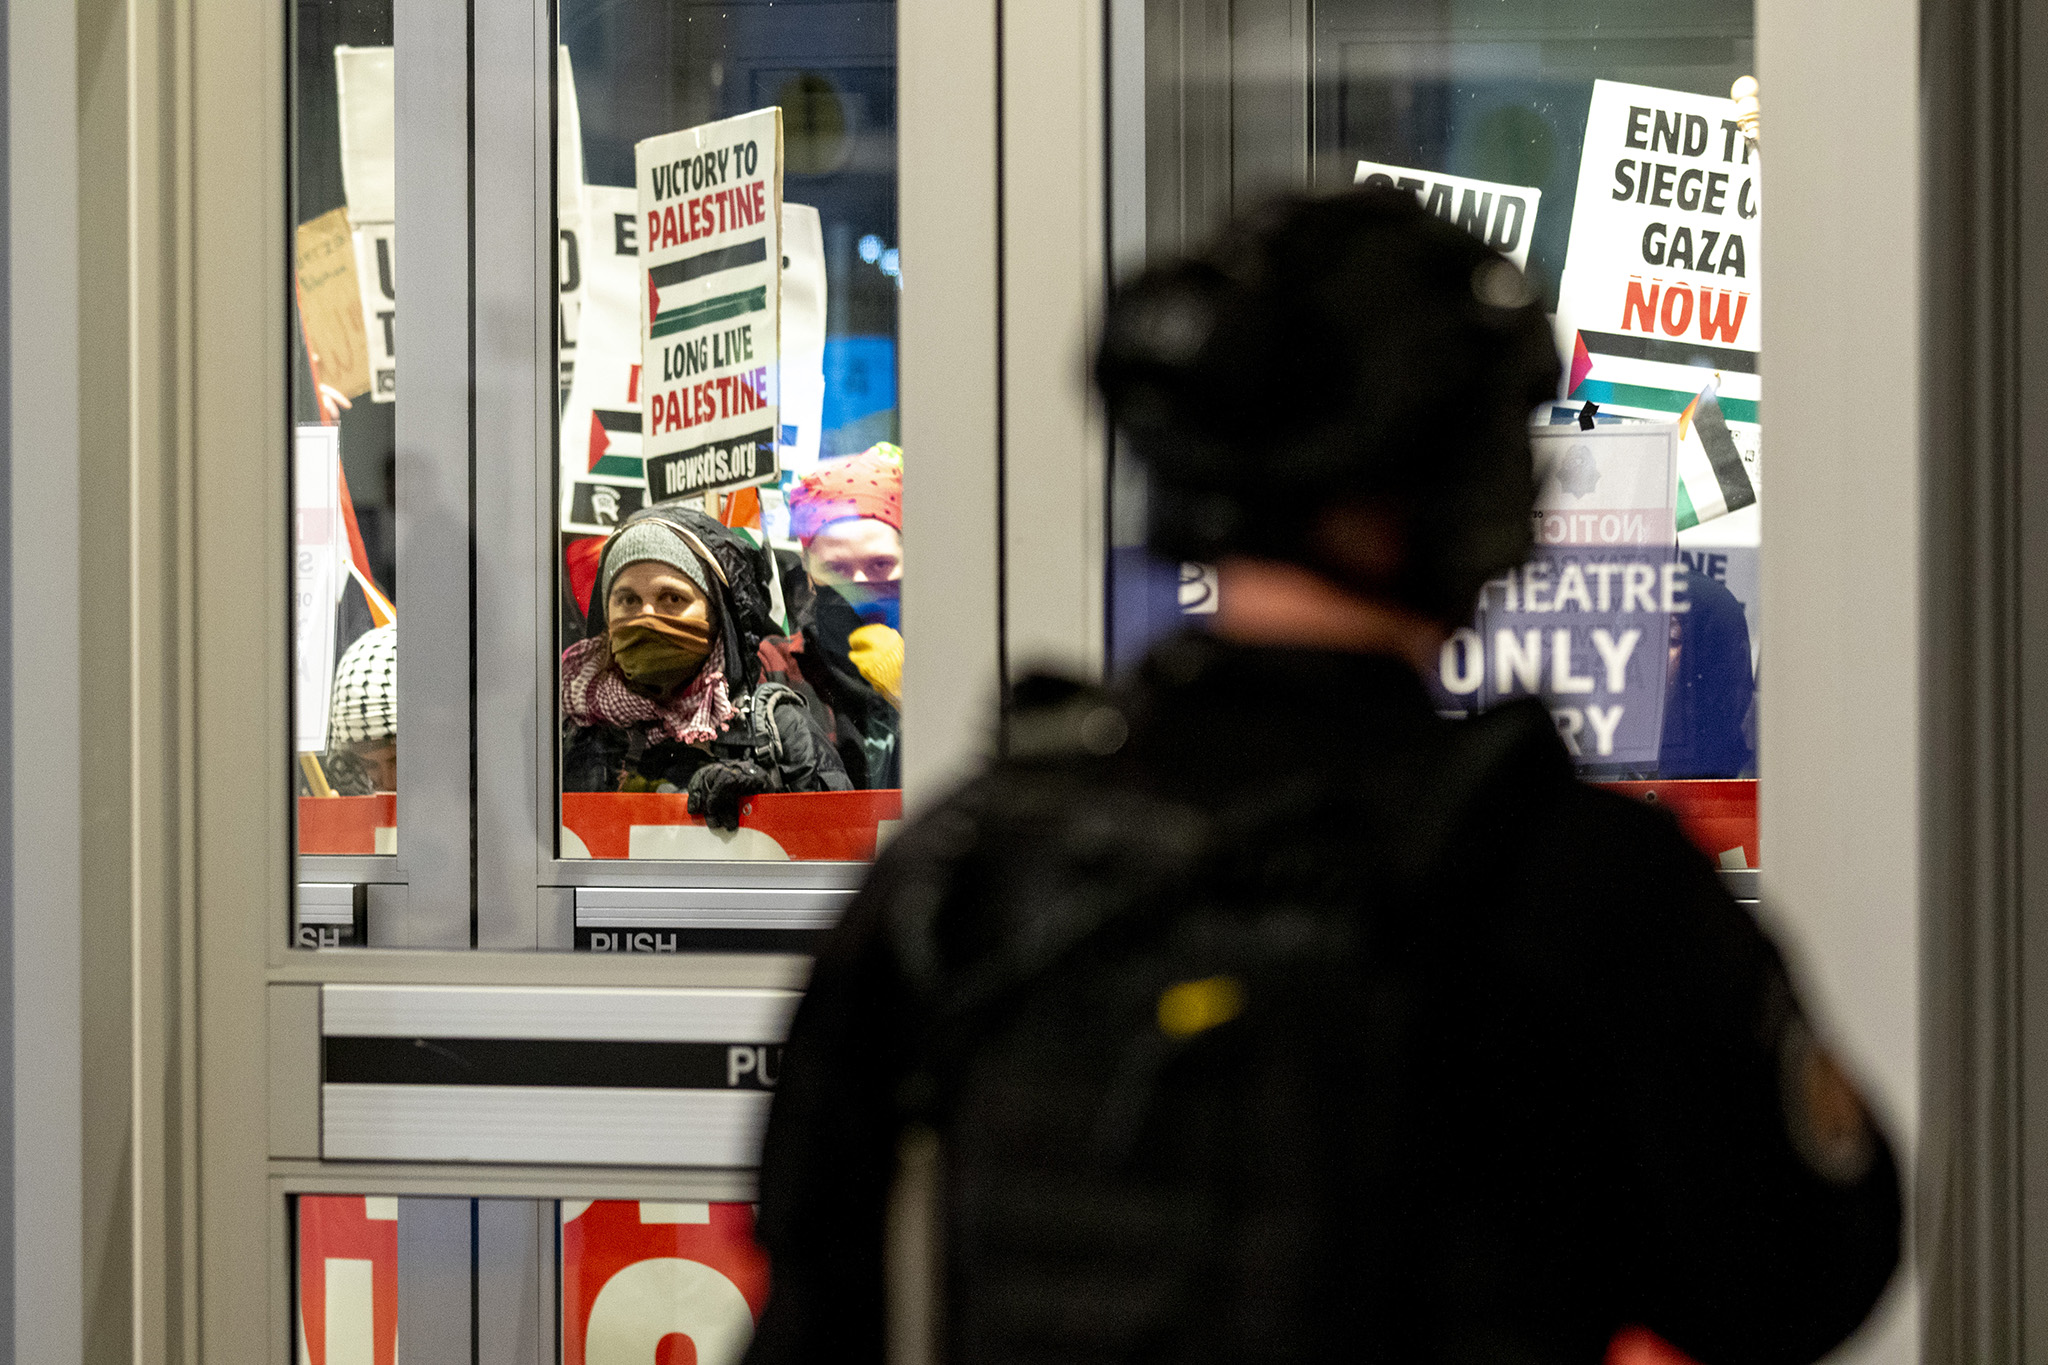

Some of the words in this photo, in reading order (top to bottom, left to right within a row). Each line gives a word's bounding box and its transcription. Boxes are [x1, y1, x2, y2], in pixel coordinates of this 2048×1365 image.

[1625, 105, 1709, 157] END
[652, 146, 729, 201] VICTORY
[733, 140, 758, 179] TO
[1612, 158, 1730, 216] SIEGE
[647, 180, 765, 252] PALESTINE
[1642, 222, 1746, 279] GAZA
[1620, 274, 1751, 344] NOW
[664, 336, 708, 382] LONG
[713, 324, 753, 368] LIVE
[652, 366, 768, 436] PALESTINE
[665, 441, 757, 494] newsds.org
[1440, 628, 1641, 695] ONLY
[590, 932, 677, 954] PUSH
[728, 1046, 783, 1087] PU
